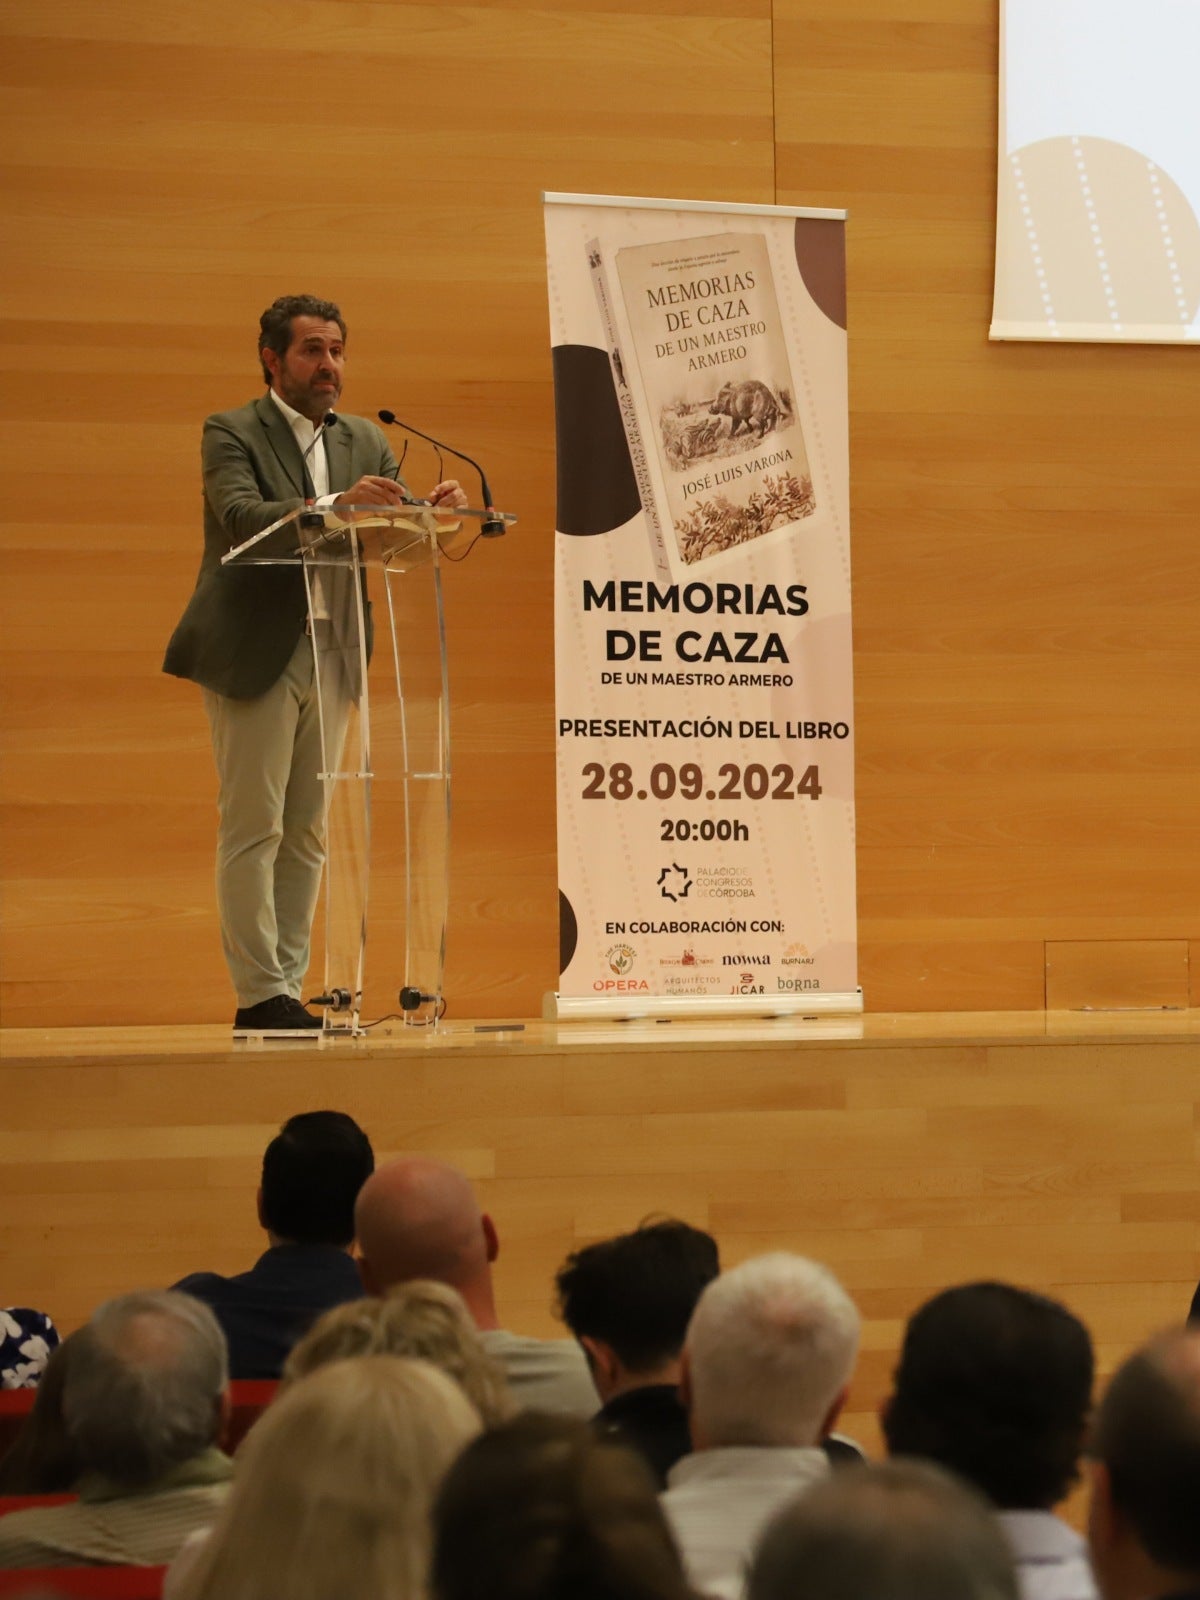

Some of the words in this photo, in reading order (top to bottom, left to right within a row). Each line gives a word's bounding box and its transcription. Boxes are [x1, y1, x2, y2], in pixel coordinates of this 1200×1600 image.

[646, 271, 756, 309] MEMORIAS
[665, 310, 692, 332] DE
[697, 299, 750, 326] CAZA
[655, 341, 675, 358] DE
[677, 336, 700, 353] UN
[703, 321, 766, 347] MAESTRO
[688, 345, 747, 372] ARMERO
[682, 473, 712, 500] JOSÉ
[715, 467, 743, 487] LUIS
[745, 449, 793, 475] VARONA
[583, 580, 810, 616] MEMORIAS
[605, 630, 662, 661] DE
[675, 631, 790, 663] CAZA
[601, 672, 623, 685] DE
[626, 672, 648, 685] UN
[652, 673, 725, 686] MAESTRO
[728, 674, 794, 687] ARMERO
[559, 716, 733, 738] PRESENTACIÓN
[739, 720, 780, 738] DEL
[786, 721, 850, 739] LIBRO
[581, 763, 823, 800] 28.09.2024
[660, 819, 750, 841] 20:00h
[696, 878, 753, 887] CONGRESOS
[605, 922, 627, 934] EN
[629, 918, 747, 934] COLABORACIÓN
[750, 920, 785, 933] CON:
[593, 980, 649, 991] OPERA
[664, 977, 721, 985] ARQUITECTOS
[730, 985, 765, 995] JICAR
